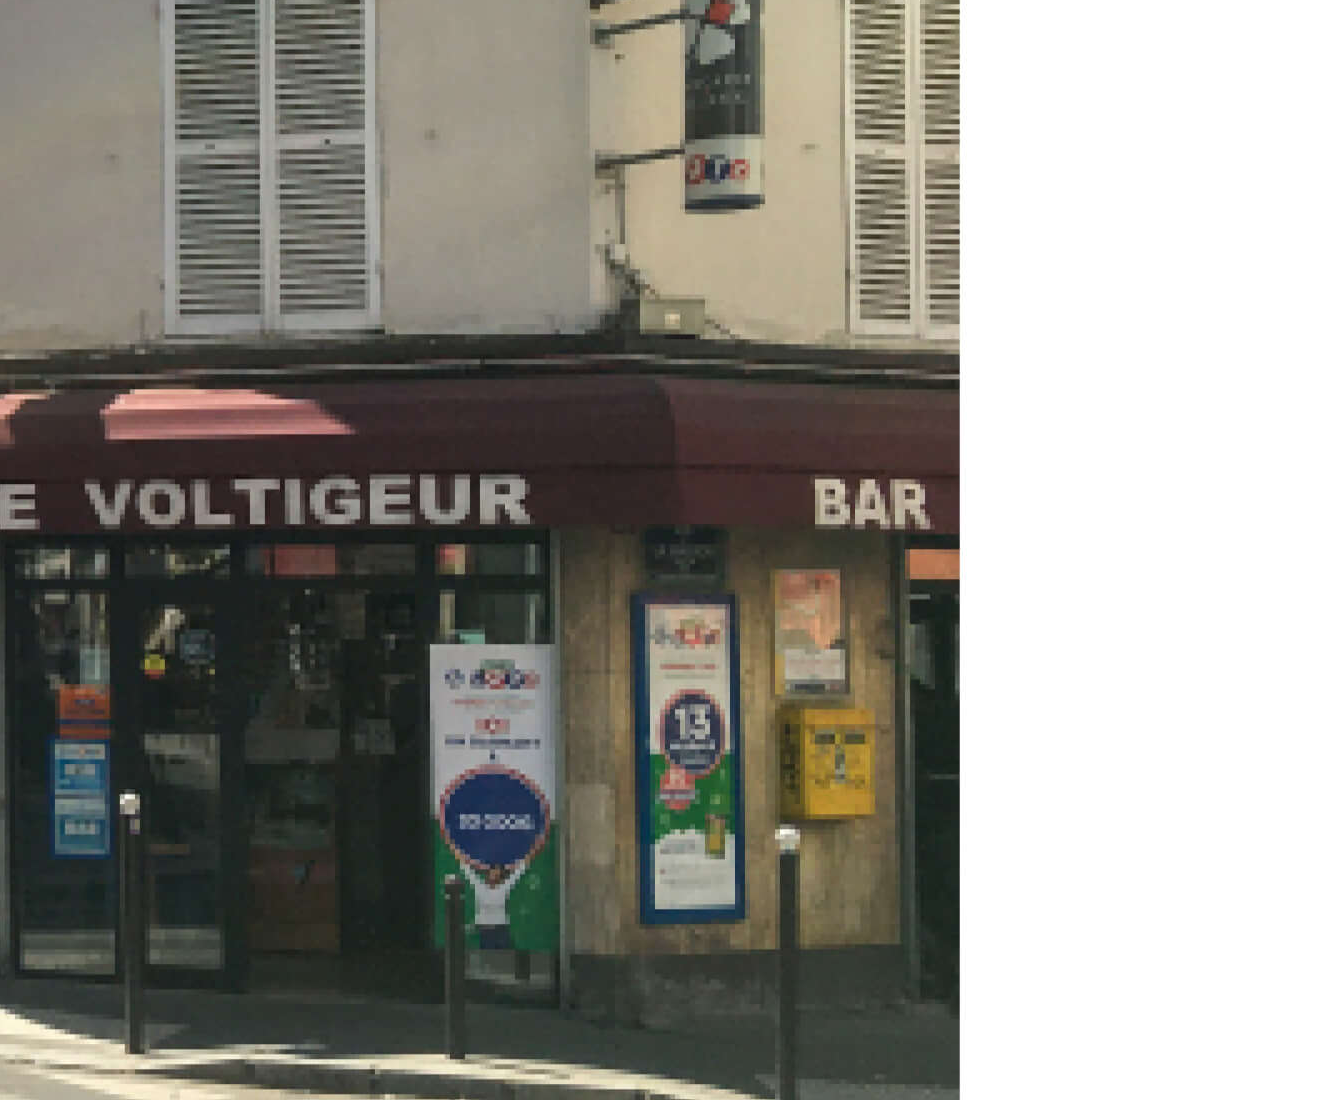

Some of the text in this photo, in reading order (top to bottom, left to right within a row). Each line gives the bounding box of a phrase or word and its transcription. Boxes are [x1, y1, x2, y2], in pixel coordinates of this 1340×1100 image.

[83, 474, 533, 529] VOLTIGEUR
[812, 476, 934, 530] BAR
[674, 703, 711, 740] 13
